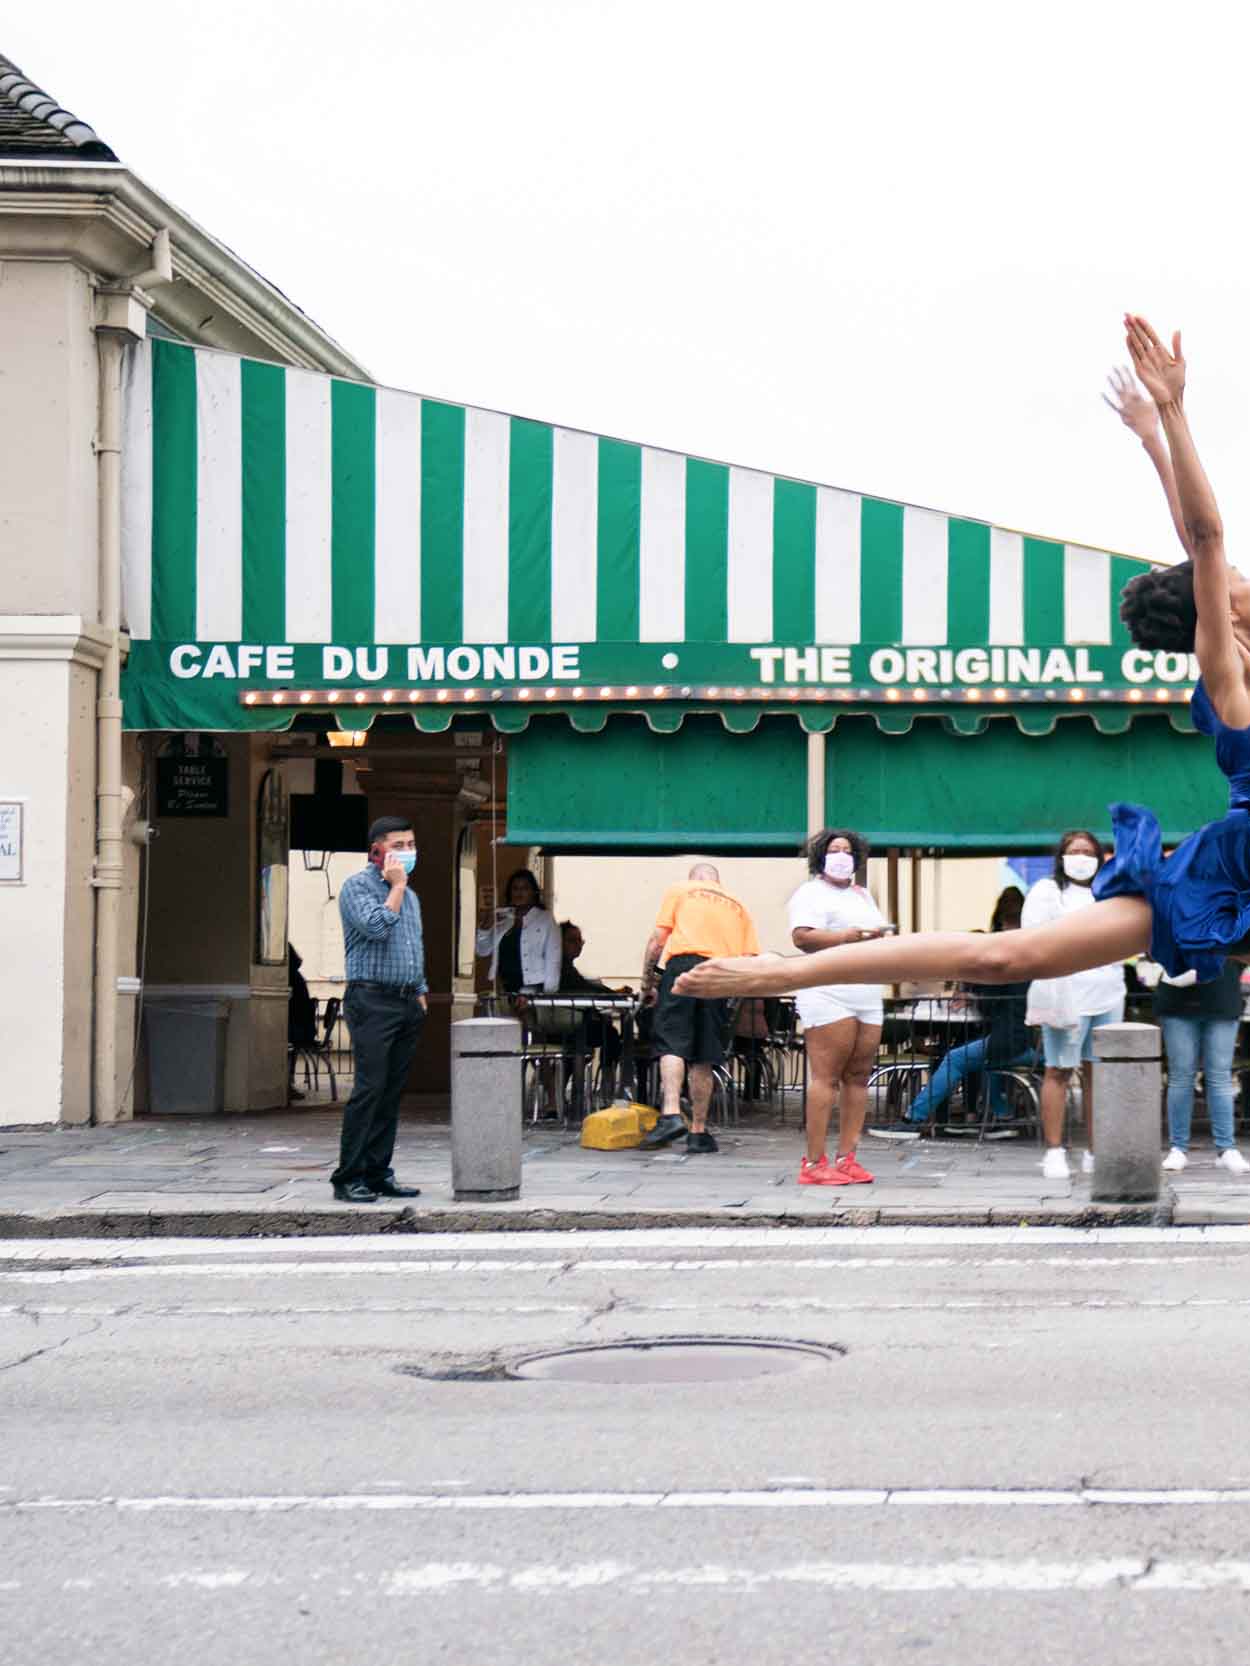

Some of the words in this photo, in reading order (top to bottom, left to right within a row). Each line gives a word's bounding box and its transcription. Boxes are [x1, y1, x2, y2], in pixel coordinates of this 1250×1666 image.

[170, 645, 295, 679] CAFE
[322, 646, 389, 680] DU
[407, 646, 581, 681] MONDE
[750, 647, 851, 682] THE
[869, 648, 1104, 683] ORIGINAL
